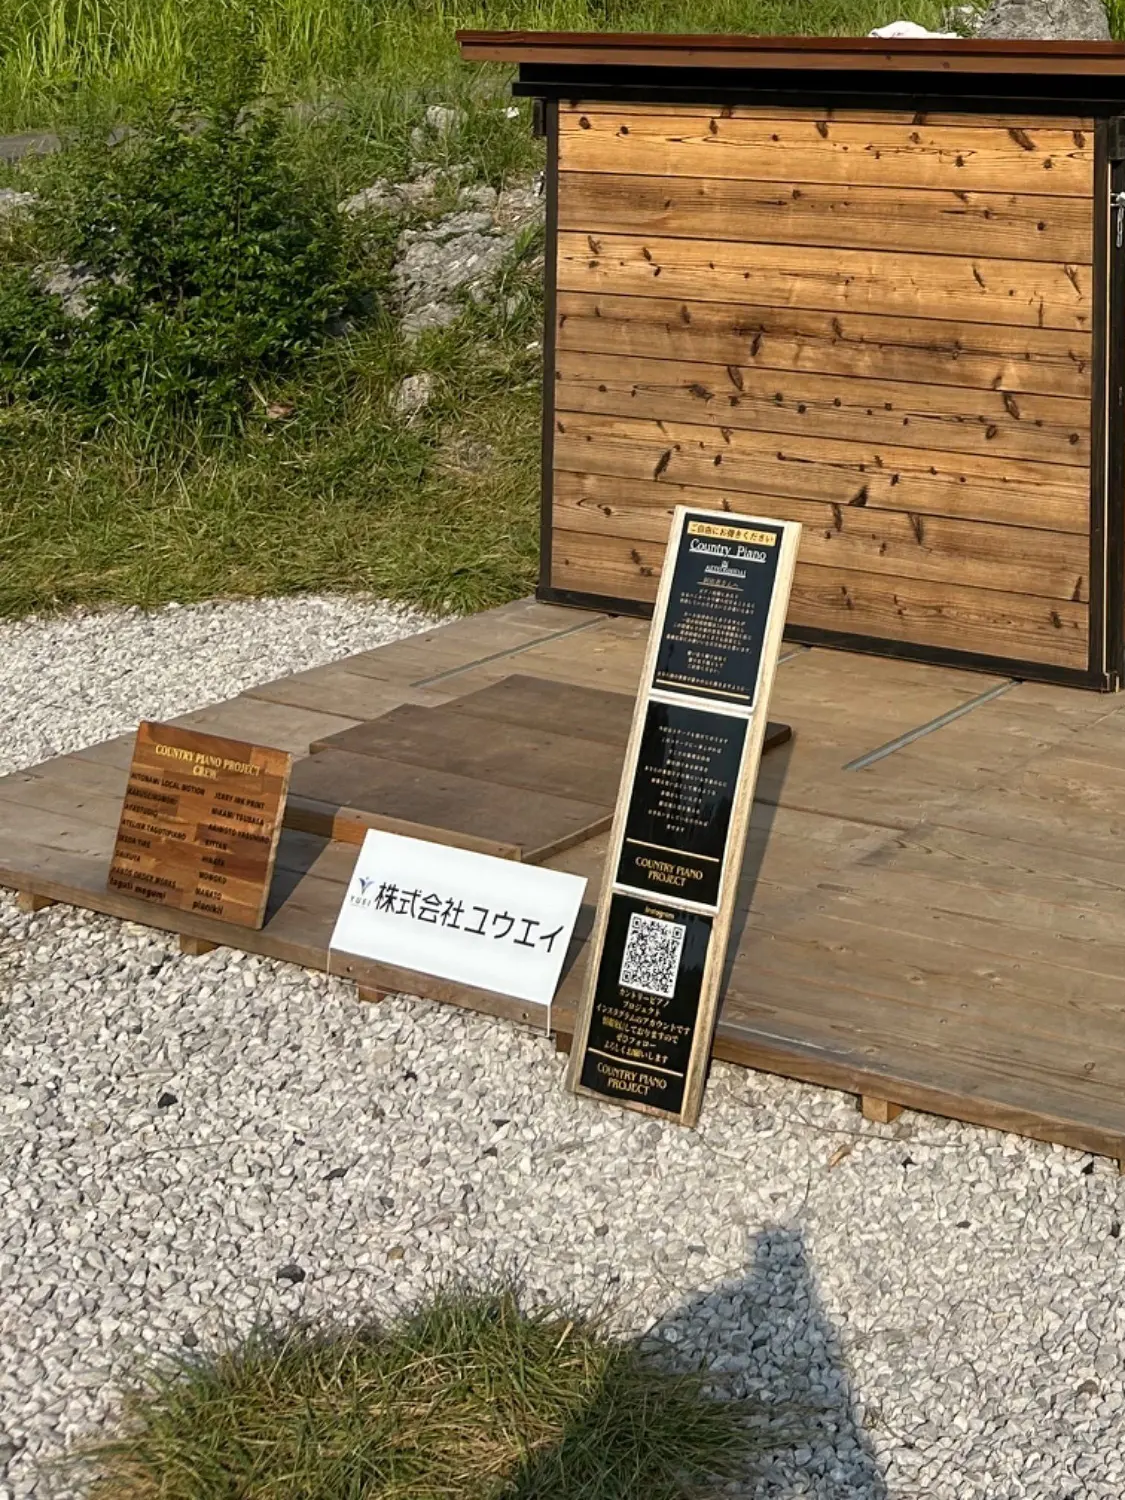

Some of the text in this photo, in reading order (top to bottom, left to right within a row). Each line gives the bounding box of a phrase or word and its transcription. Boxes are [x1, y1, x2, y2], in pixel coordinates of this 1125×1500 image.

[690, 538, 767, 560] Country Piano
[155, 744, 259, 776] COUNTRY PIANO PROJECT
[192, 765, 217, 779] CREW
[161, 779, 180, 789] LOCAL
[635, 856, 703, 880] COUNTRY PIANO
[648, 870, 685, 886] PROJECT
[375, 882, 564, 953] 株式会社ユウエイ
[597, 1062, 667, 1089] COUNTRY PIANO
[608, 1076, 649, 1097] PROJECT
